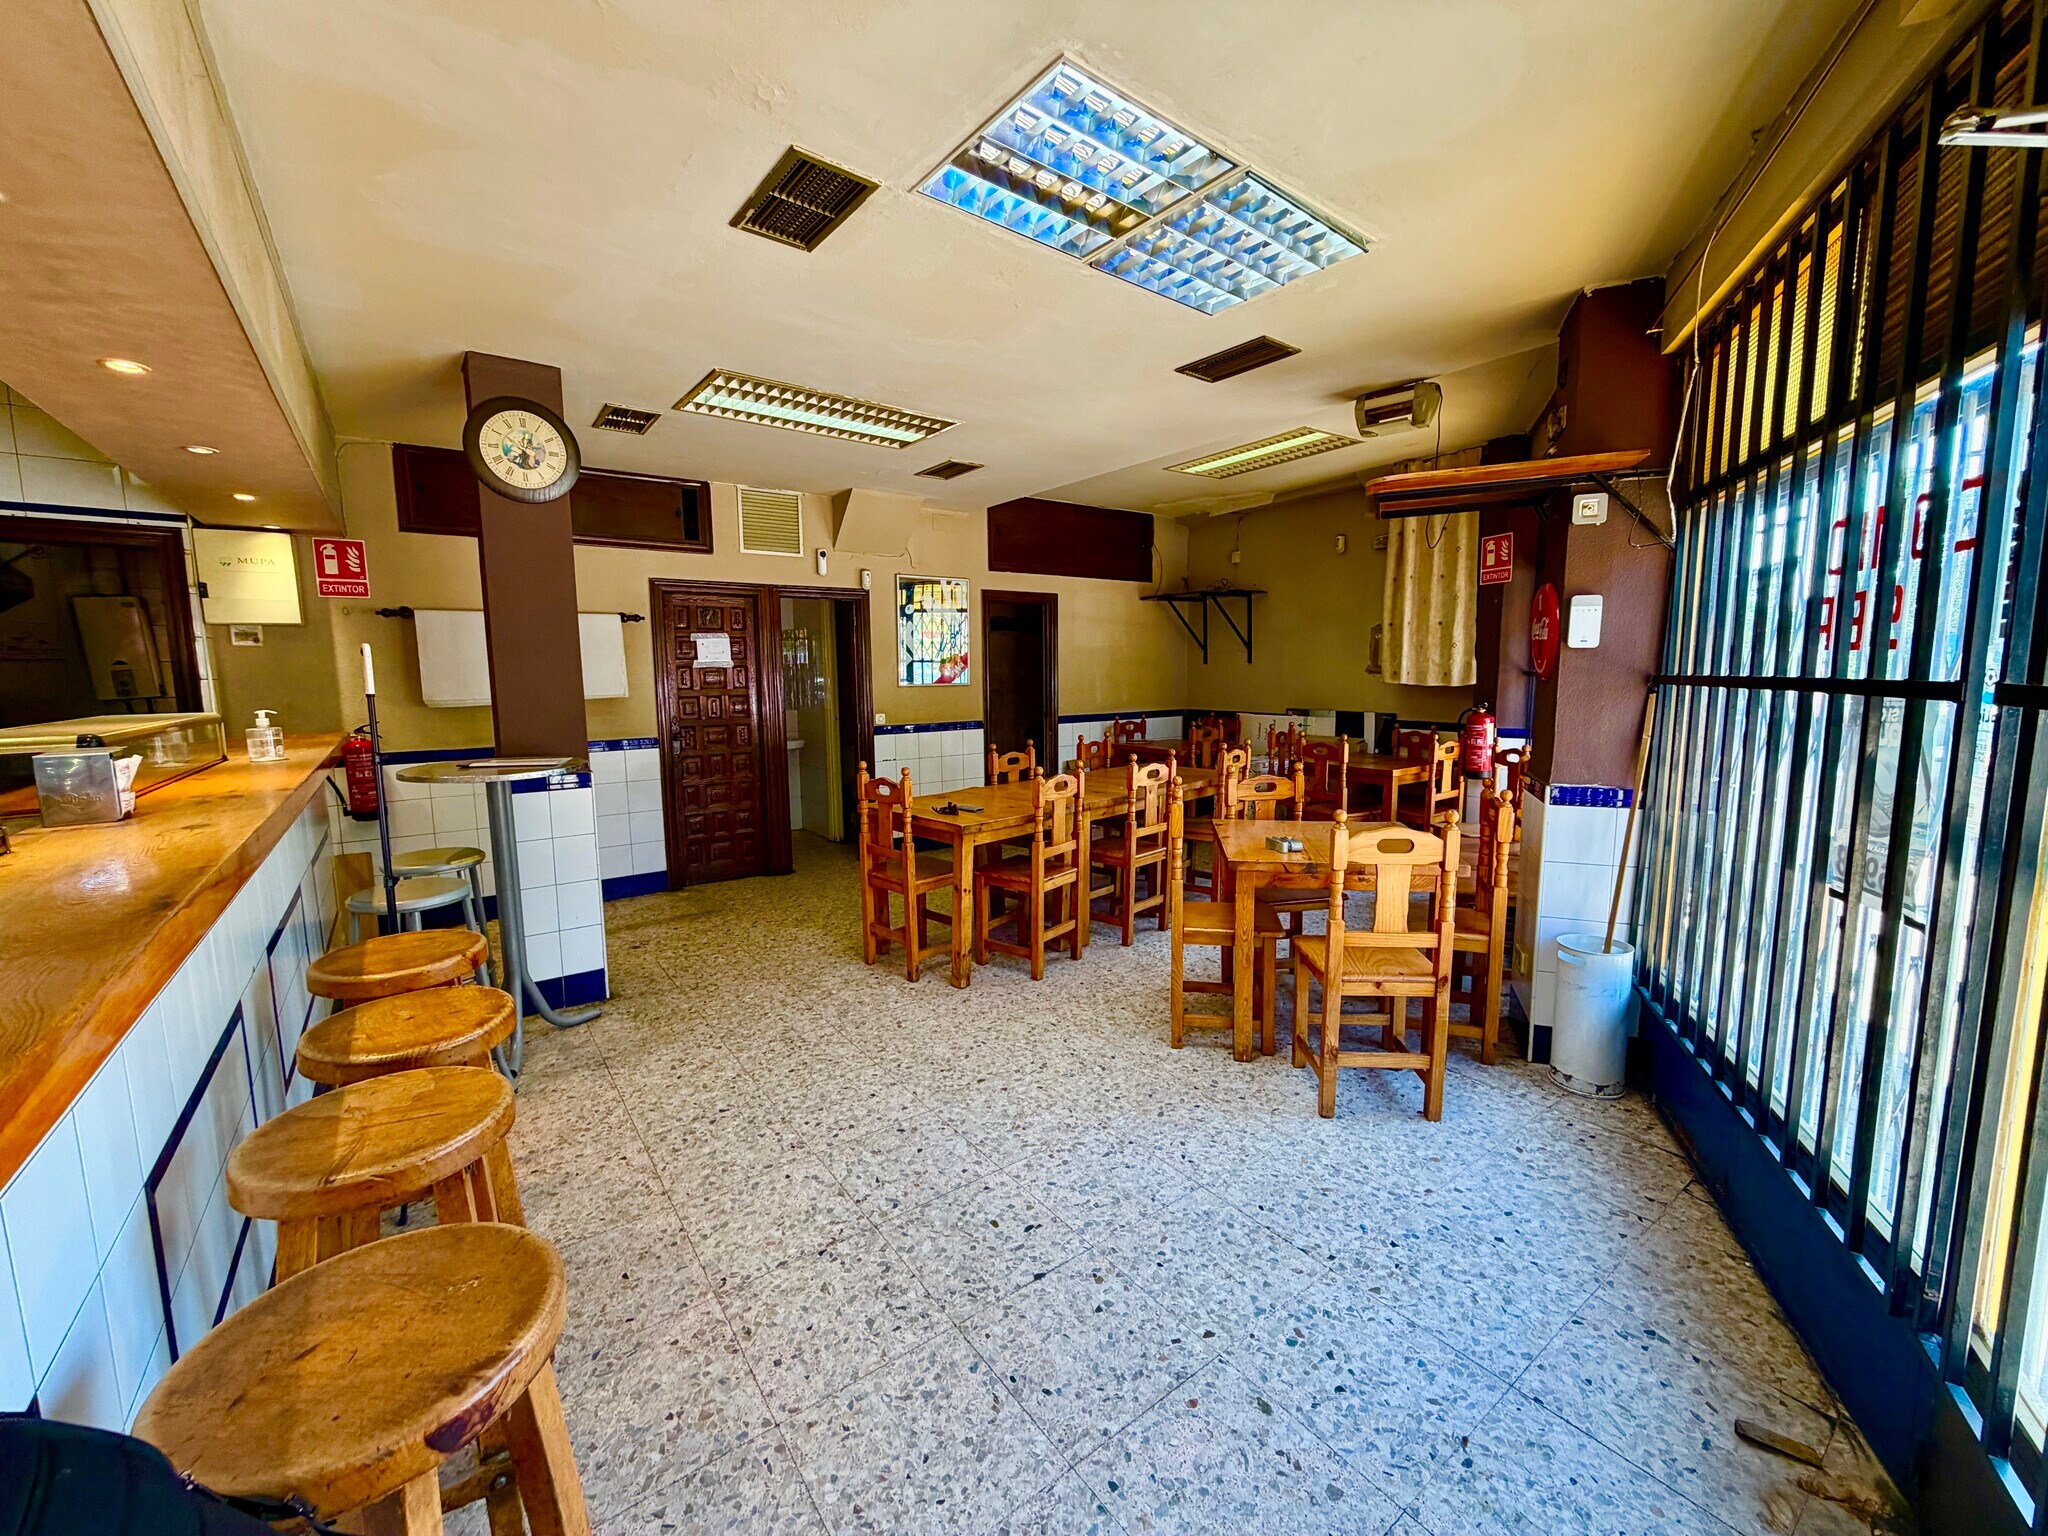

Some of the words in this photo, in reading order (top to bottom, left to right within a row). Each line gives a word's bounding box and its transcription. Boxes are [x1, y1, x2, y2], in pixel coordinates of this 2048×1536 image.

[237, 557, 275, 566] MUPA
[1482, 571, 1509, 581] EXTINTOR
[322, 584, 365, 594] EXTINTOR
